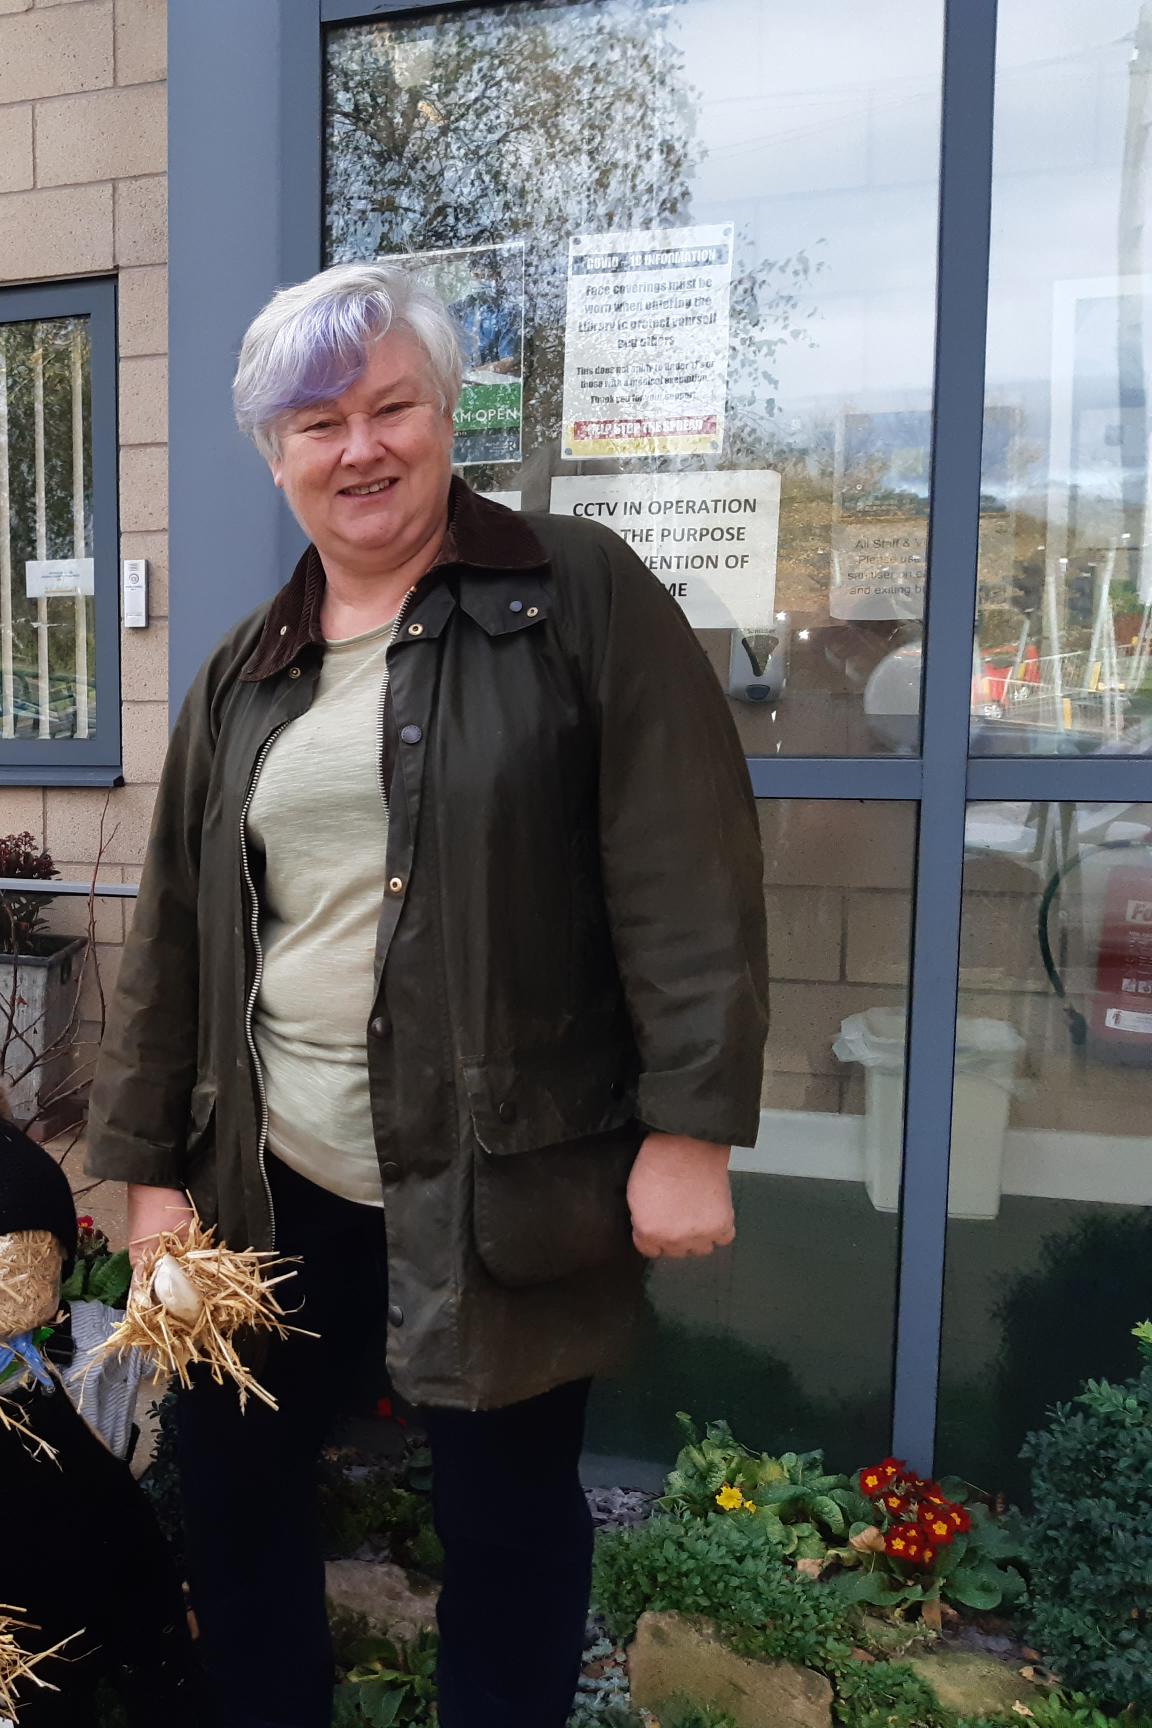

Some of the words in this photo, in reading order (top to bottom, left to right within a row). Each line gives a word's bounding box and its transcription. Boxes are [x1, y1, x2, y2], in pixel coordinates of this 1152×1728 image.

[586, 256, 619, 270] COVID
[644, 248, 716, 266] INFORMATION
[586, 285, 610, 296] Face
[613, 280, 667, 295] coverings
[668, 278, 696, 291] must
[698, 278, 713, 289] be
[584, 302, 612, 314] worn
[614, 300, 642, 312] when
[644, 298, 692, 312] entering
[694, 296, 712, 307] the
[630, 317, 670, 330] protect
[618, 338, 637, 349] and
[640, 335, 675, 348] others
[576, 367, 594, 376] This
[616, 364, 629, 374] not
[590, 395, 615, 404] Thank
[475, 407, 517, 422] OPEN
[572, 502, 618, 517] CCTV
[623, 501, 642, 516] IN
[648, 498, 757, 516] OPERATION
[620, 528, 654, 543] THE
[660, 526, 746, 542] PURPOSE
[725, 554, 750, 569] OF
[849, 584, 871, 595] and
